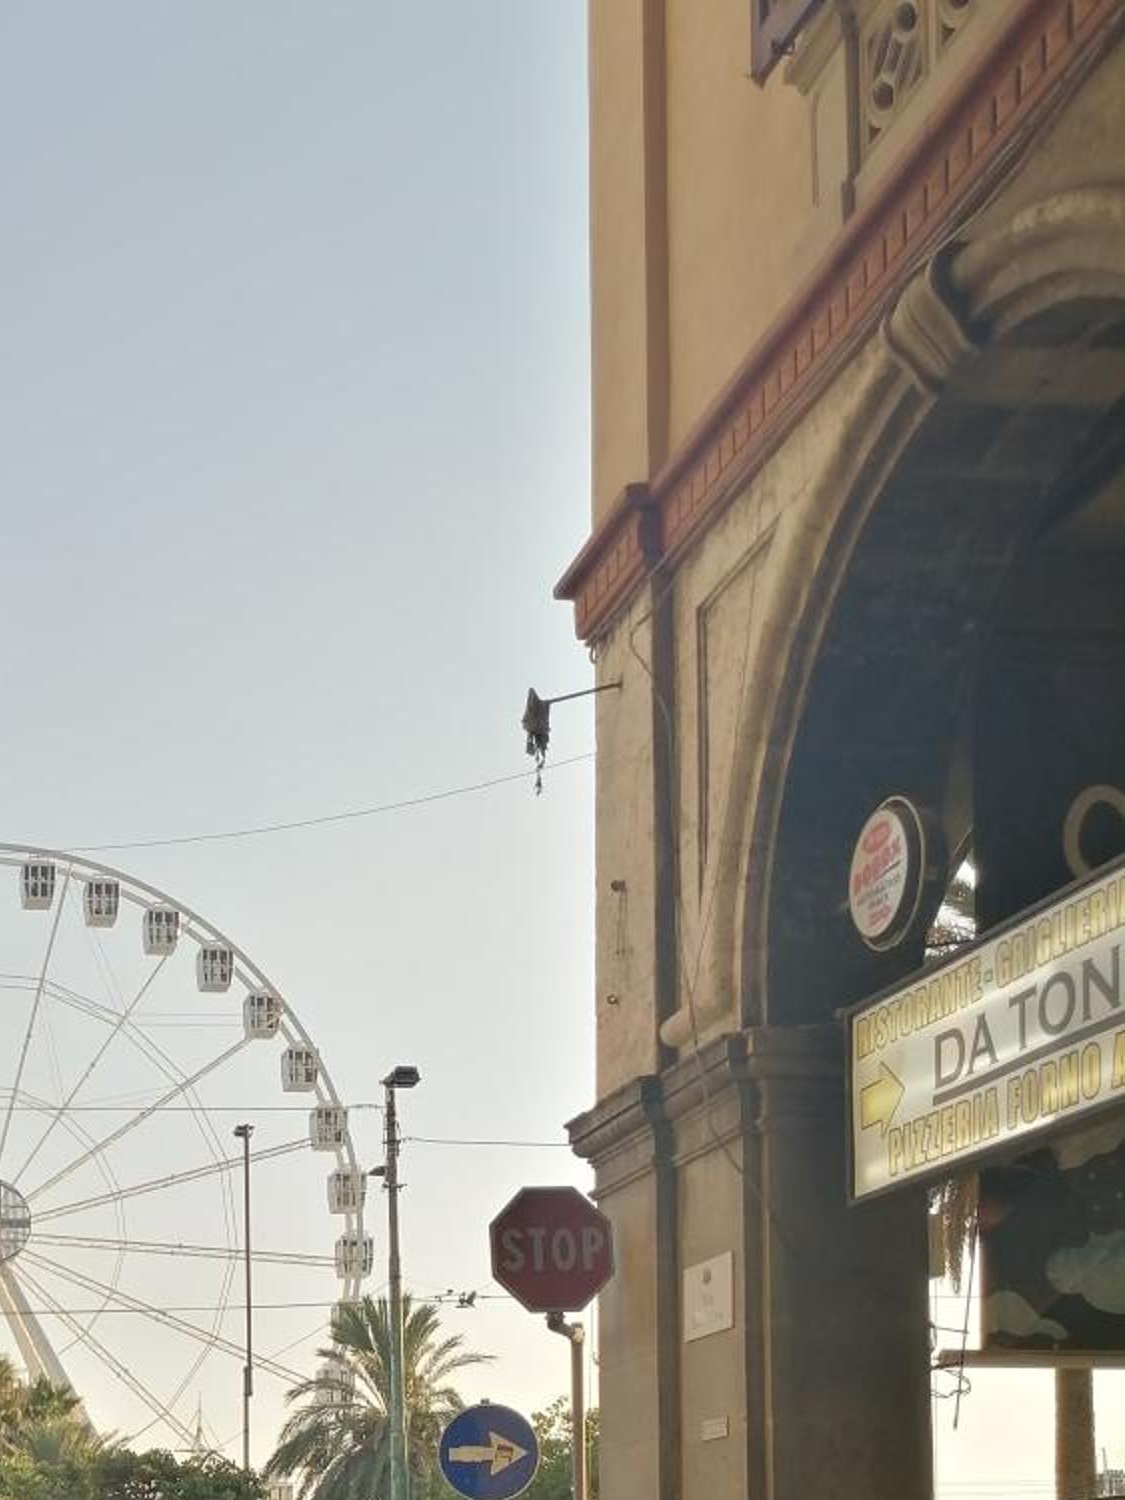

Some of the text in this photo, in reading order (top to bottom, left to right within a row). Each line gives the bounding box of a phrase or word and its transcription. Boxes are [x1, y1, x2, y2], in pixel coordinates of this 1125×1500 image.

[934, 1011, 999, 1089] DA
[888, 1086, 999, 1176] PIZZERIA
[1006, 1041, 1102, 1131] FORNO
[501, 1226, 604, 1272] STOP
